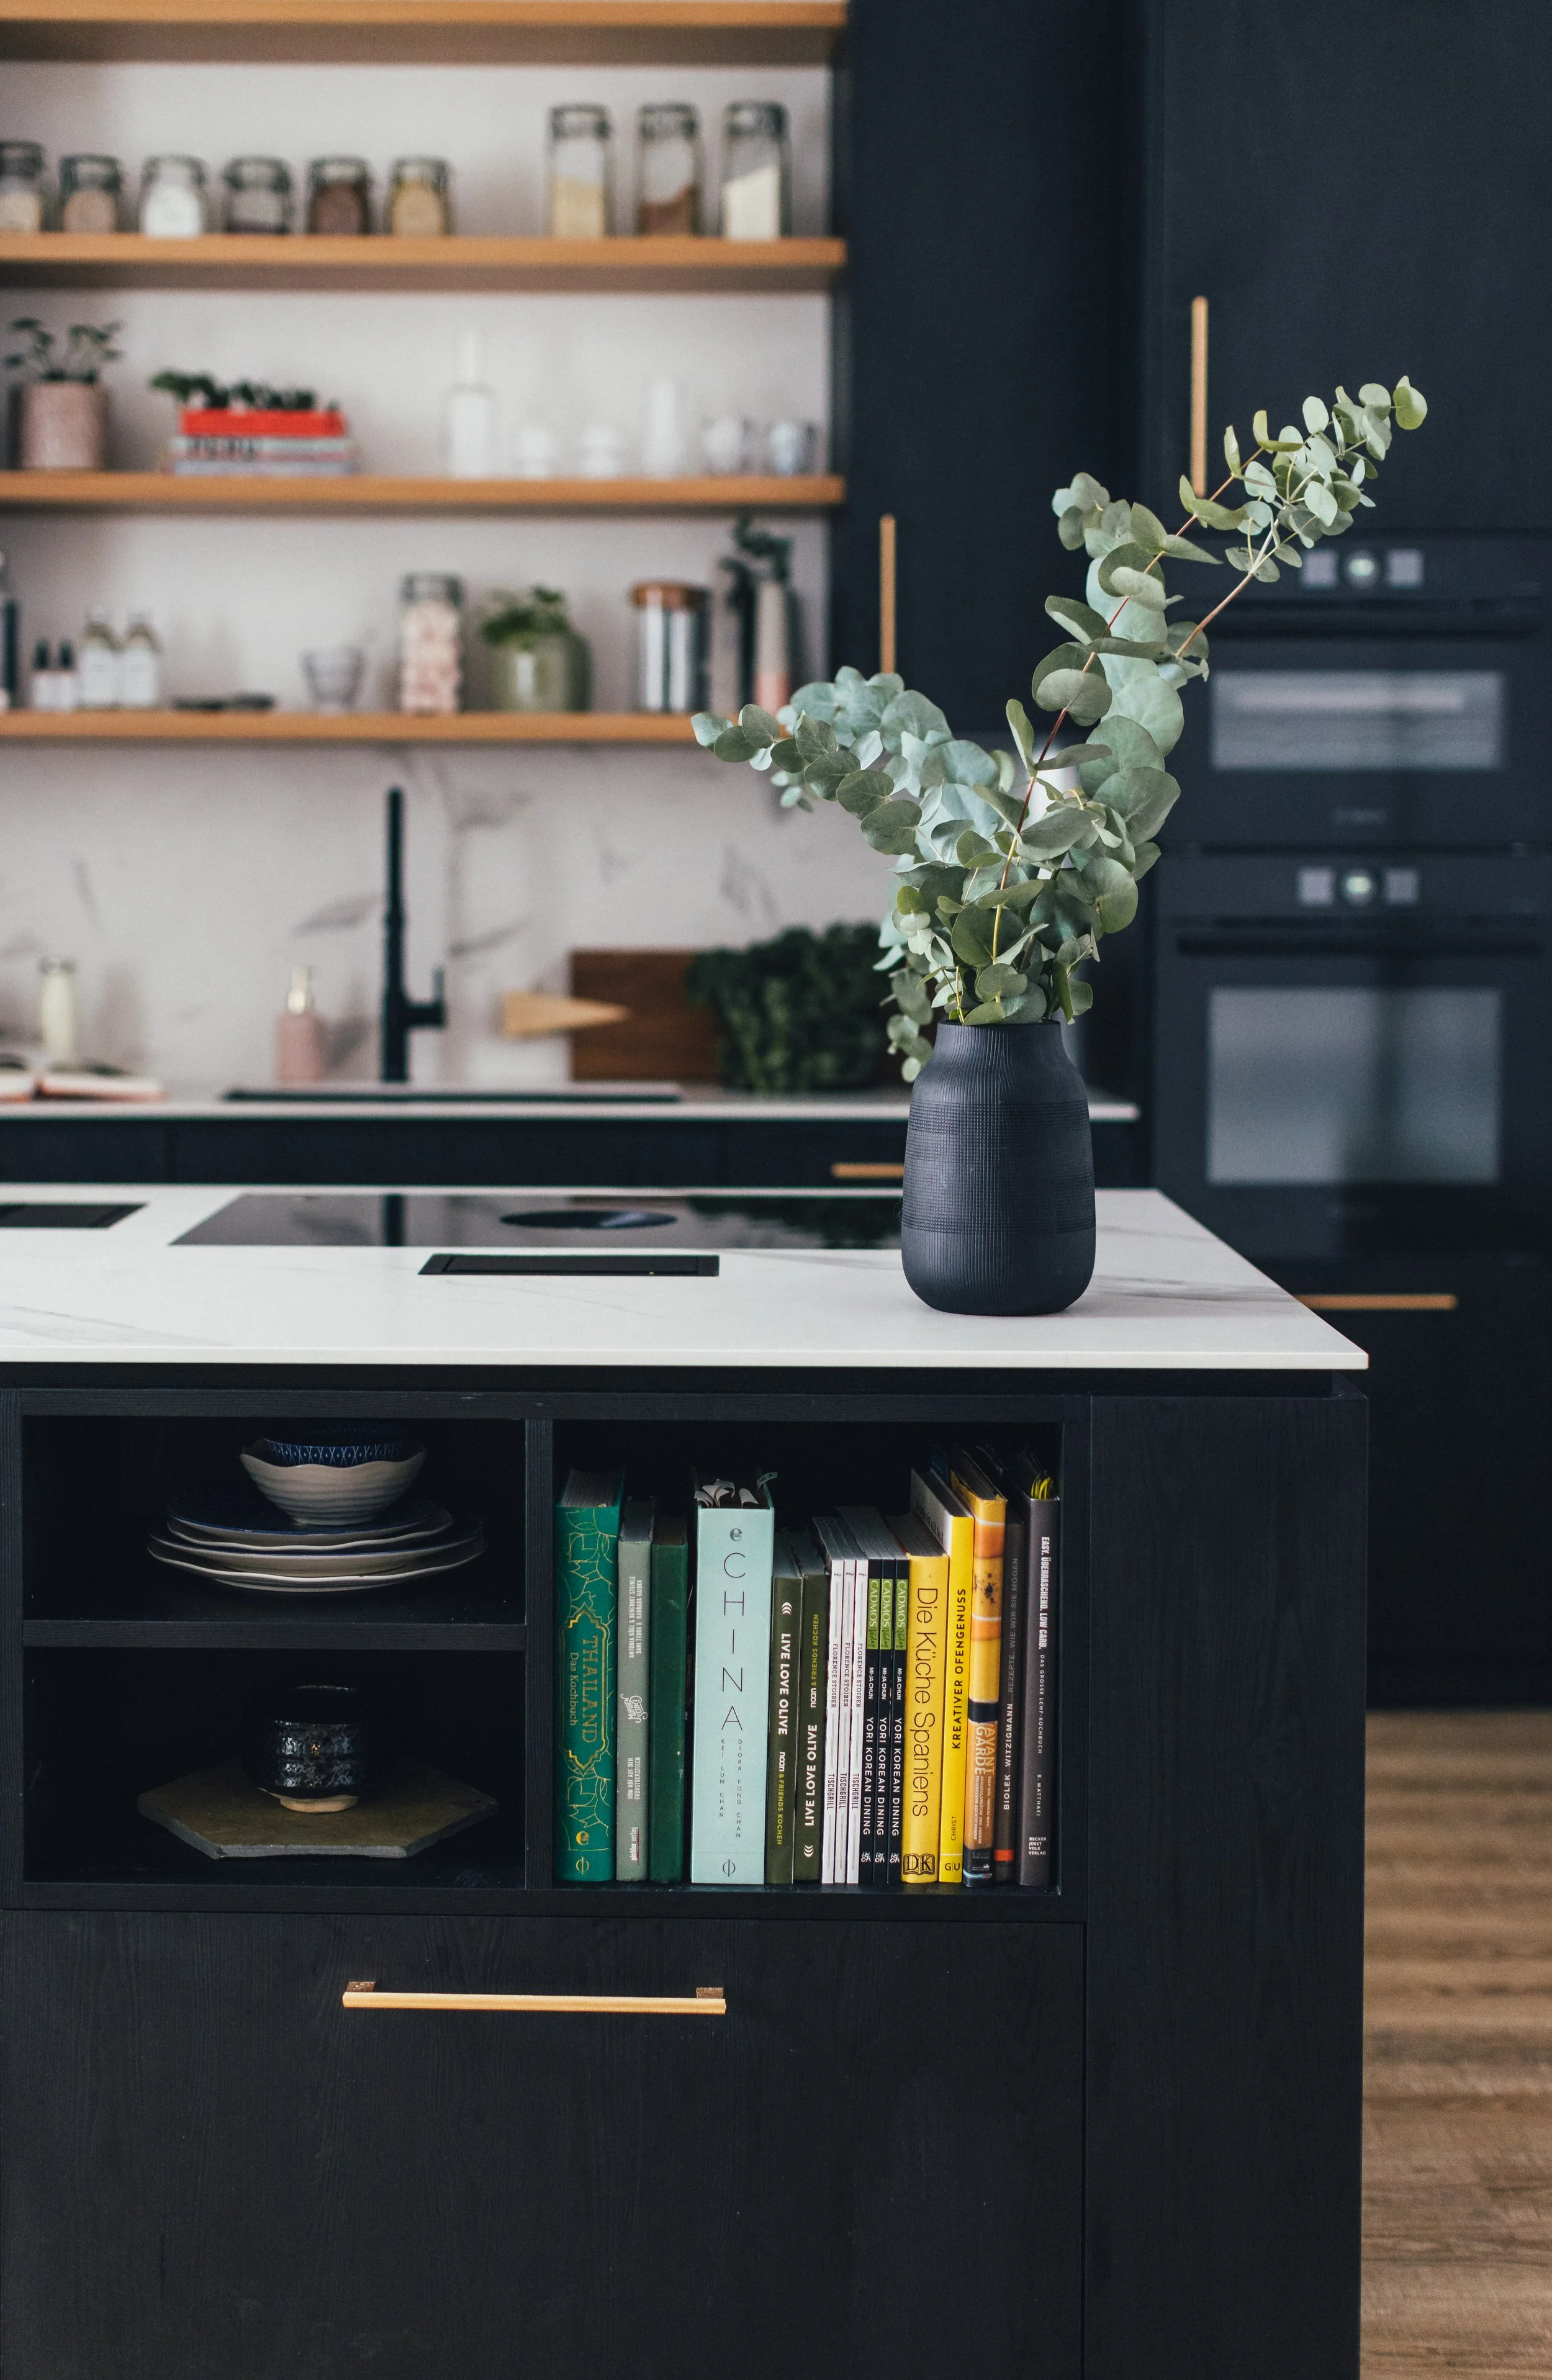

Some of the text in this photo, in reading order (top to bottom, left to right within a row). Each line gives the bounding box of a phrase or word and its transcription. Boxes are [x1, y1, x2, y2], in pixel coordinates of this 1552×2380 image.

[1041, 1536, 1050, 1555] EASY.
[869, 1580, 878, 1626] CADMOS
[882, 1580, 891, 1627] CADMOS
[897, 1580, 906, 1628] CADMOS
[1040, 1557, 1051, 1611] ÜBERRASCHEND.
[721, 1553, 746, 1731] CHINA
[1039, 1613, 1048, 1628] LOW
[1039, 1629, 1047, 1650] CARB.
[569, 1652, 579, 1726] Das Kochbuch
[582, 1635, 598, 1744] THAILAND
[778, 1633, 792, 1736] LIVE LOVE OLIVE
[952, 1589, 966, 1749] KREATIVER OFENGENUSS
[909, 1588, 938, 1817] Die Küche Spaniens
[975, 1726, 986, 1775] GARDE
[985, 1726, 996, 1775] AVANT
[1005, 1703, 1013, 1767] WITZIGMANN
[805, 1724, 817, 1826] LIVE LOVE OLIVE
[827, 1774, 835, 1810] TISCHGRILL
[839, 1772, 847, 1809] TISCHGRILL
[852, 1773, 860, 1810] TISCHGRILL
[863, 1717, 874, 1835] YORI KOREAN DINING
[877, 1717, 887, 1836] YORI KOREAN DINING
[891, 1718, 902, 1836] YORI KOREAN DINING
[629, 1827, 639, 1860] pichler verlag
[906, 1855, 932, 1871] DK
